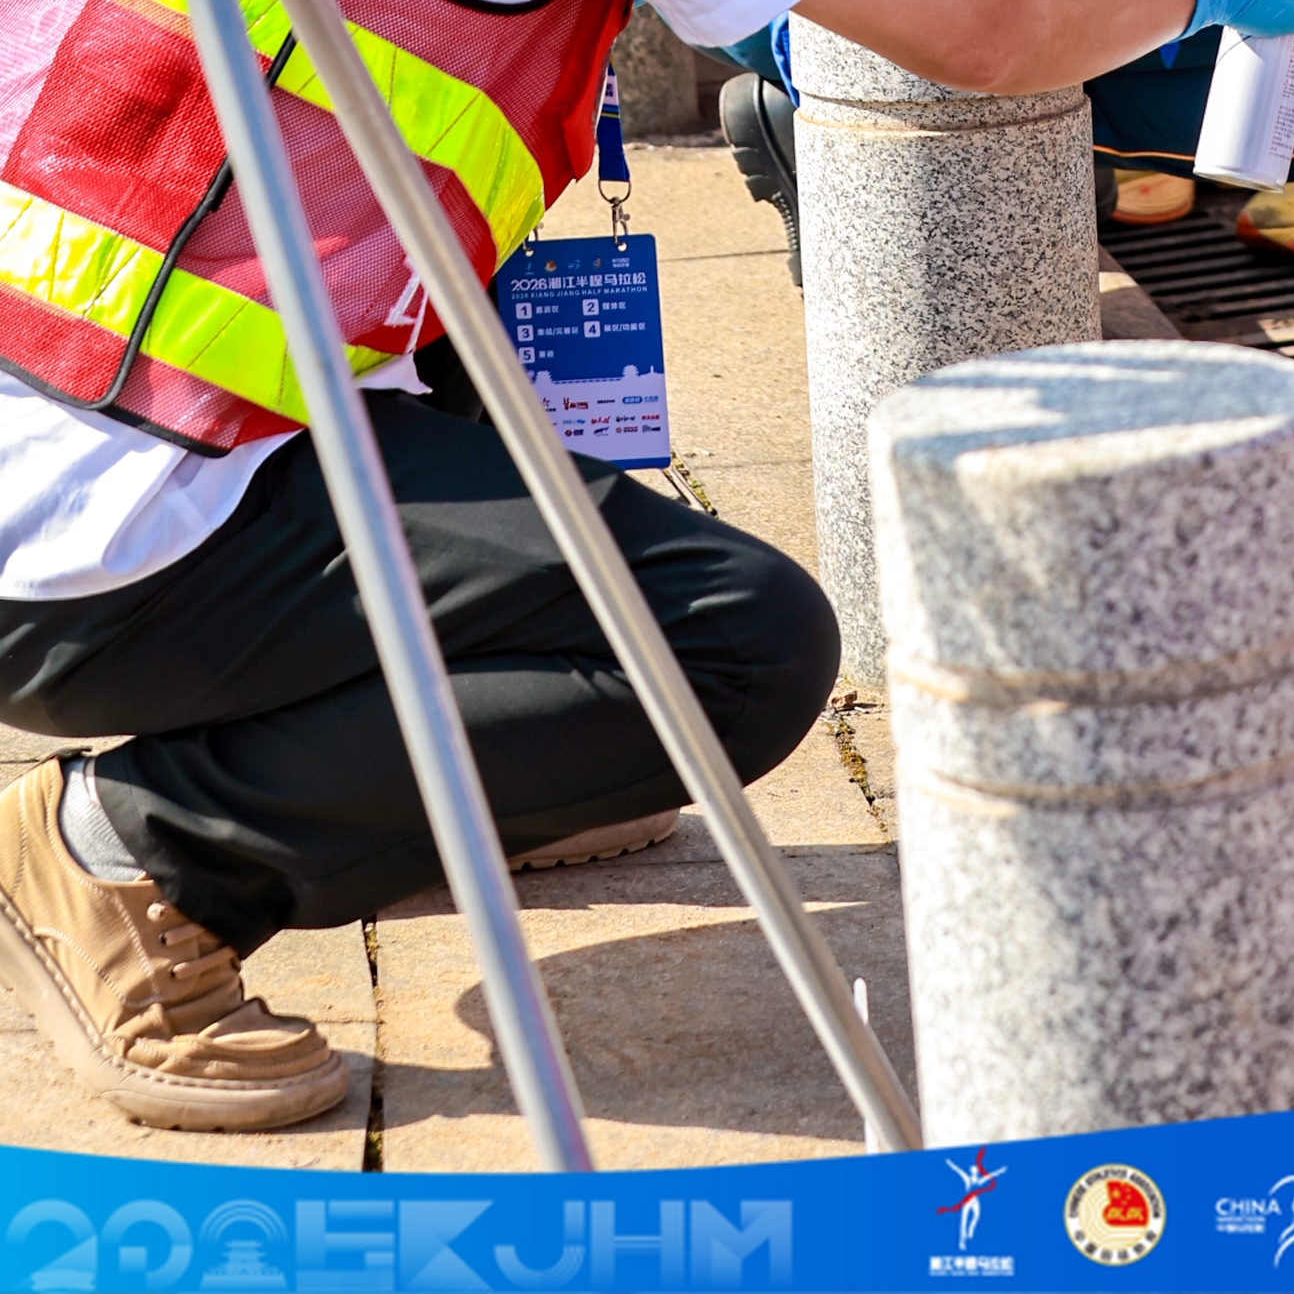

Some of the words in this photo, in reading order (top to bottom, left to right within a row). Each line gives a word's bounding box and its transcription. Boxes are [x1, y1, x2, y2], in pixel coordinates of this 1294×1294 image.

[511, 292, 529, 300] 2026
[530, 291, 555, 299] XIANG
[556, 289, 581, 298] JIANG
[581, 288, 603, 296] HALF
[603, 285, 648, 294] MARATHON
